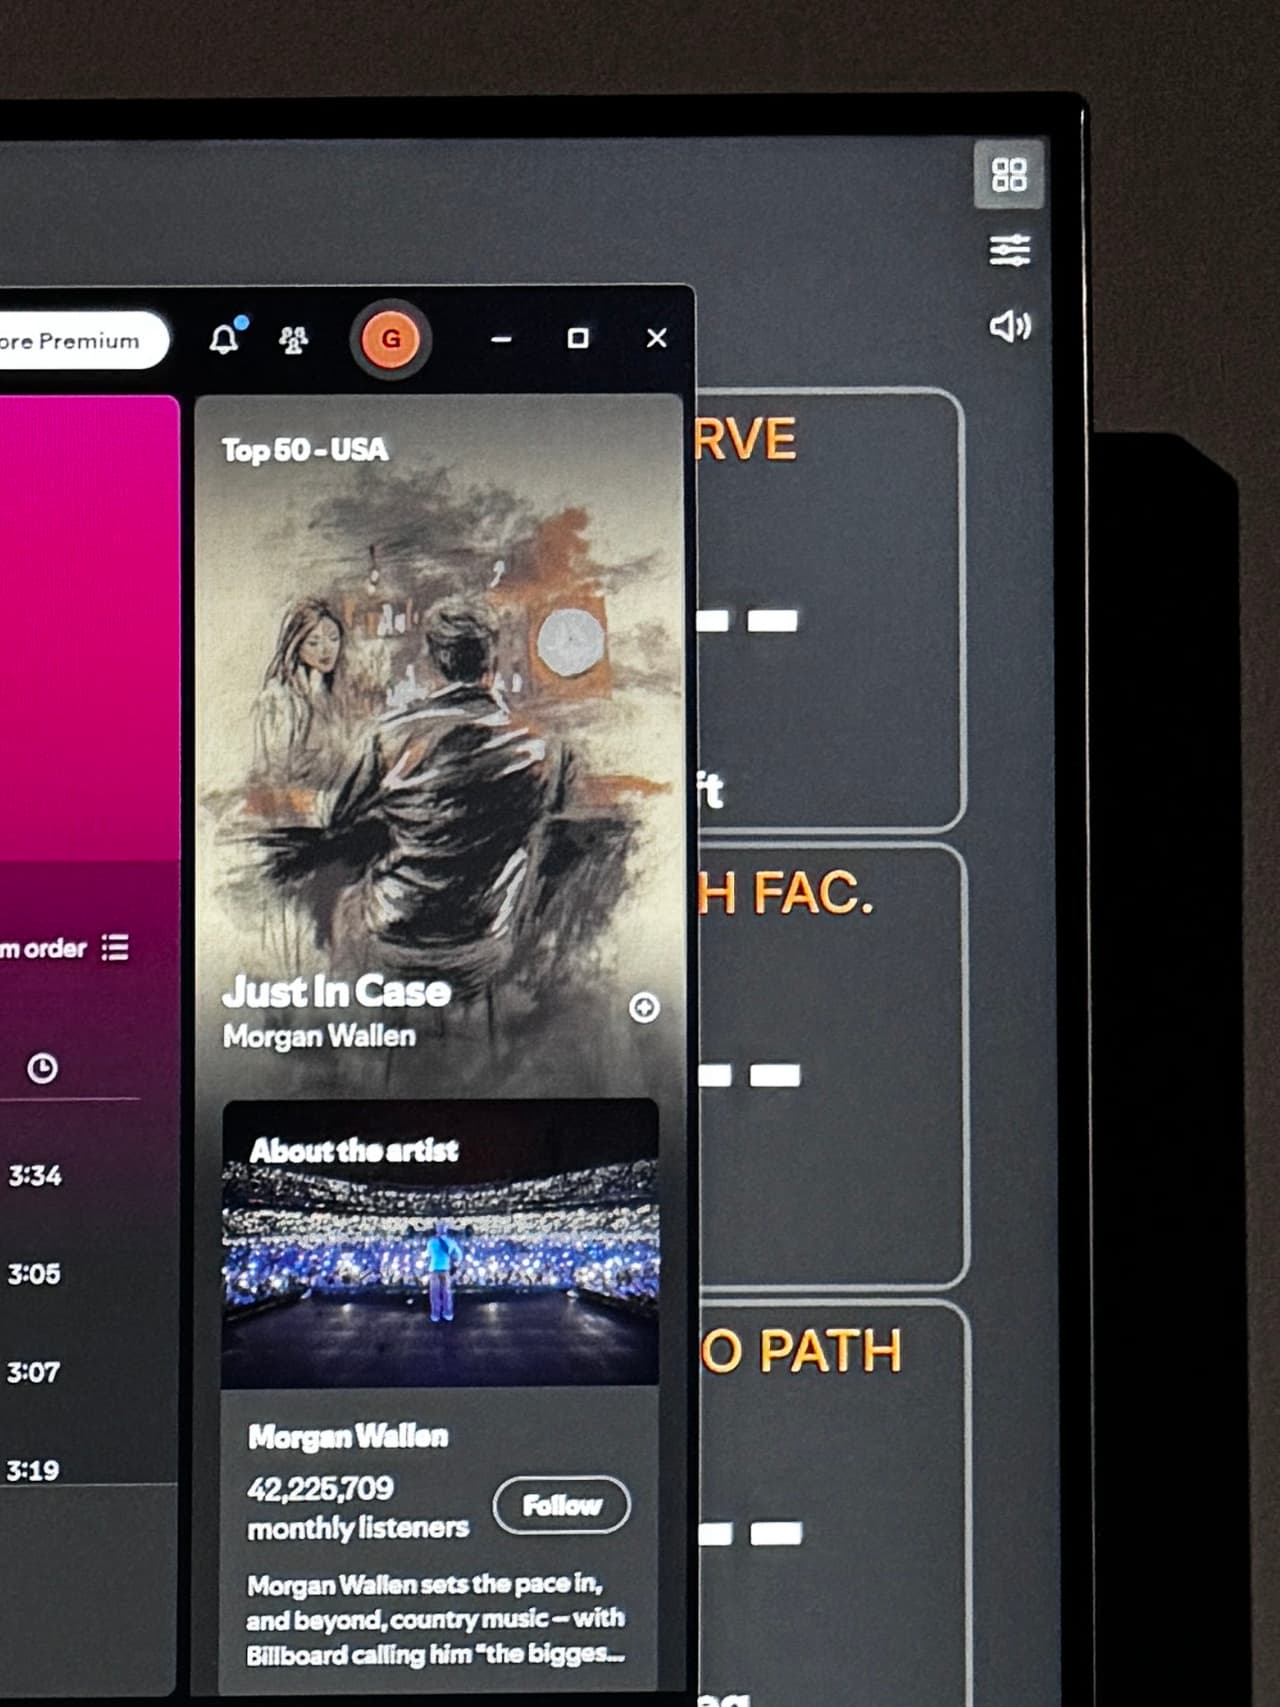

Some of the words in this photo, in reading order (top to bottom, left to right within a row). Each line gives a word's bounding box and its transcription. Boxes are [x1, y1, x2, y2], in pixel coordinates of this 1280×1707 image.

[40, 330, 139, 353] Premium
[222, 438, 269, 466] Top
[273, 437, 311, 463] 50
[330, 436, 389, 462] USA
[754, 869, 874, 915] FAC.
[24, 938, 87, 960] order
[222, 974, 308, 1009] Just
[314, 974, 350, 1008] In
[355, 974, 452, 1008] Case
[223, 1024, 323, 1053] Morgan
[327, 1023, 416, 1048] Wallen
[8, 1164, 62, 1187] 3:34
[7, 1263, 61, 1286] 3:05
[760, 1327, 902, 1374] PATH
[6, 1361, 60, 1384] 3:07
[248, 1423, 352, 1454] Morgan
[355, 1421, 449, 1449] Wallen
[6, 1460, 59, 1482] 3:19
[246, 1475, 394, 1504] 42,225,709
[522, 1493, 604, 1518] Follow
[247, 1514, 355, 1544] monthly
[358, 1515, 470, 1540] listeners
